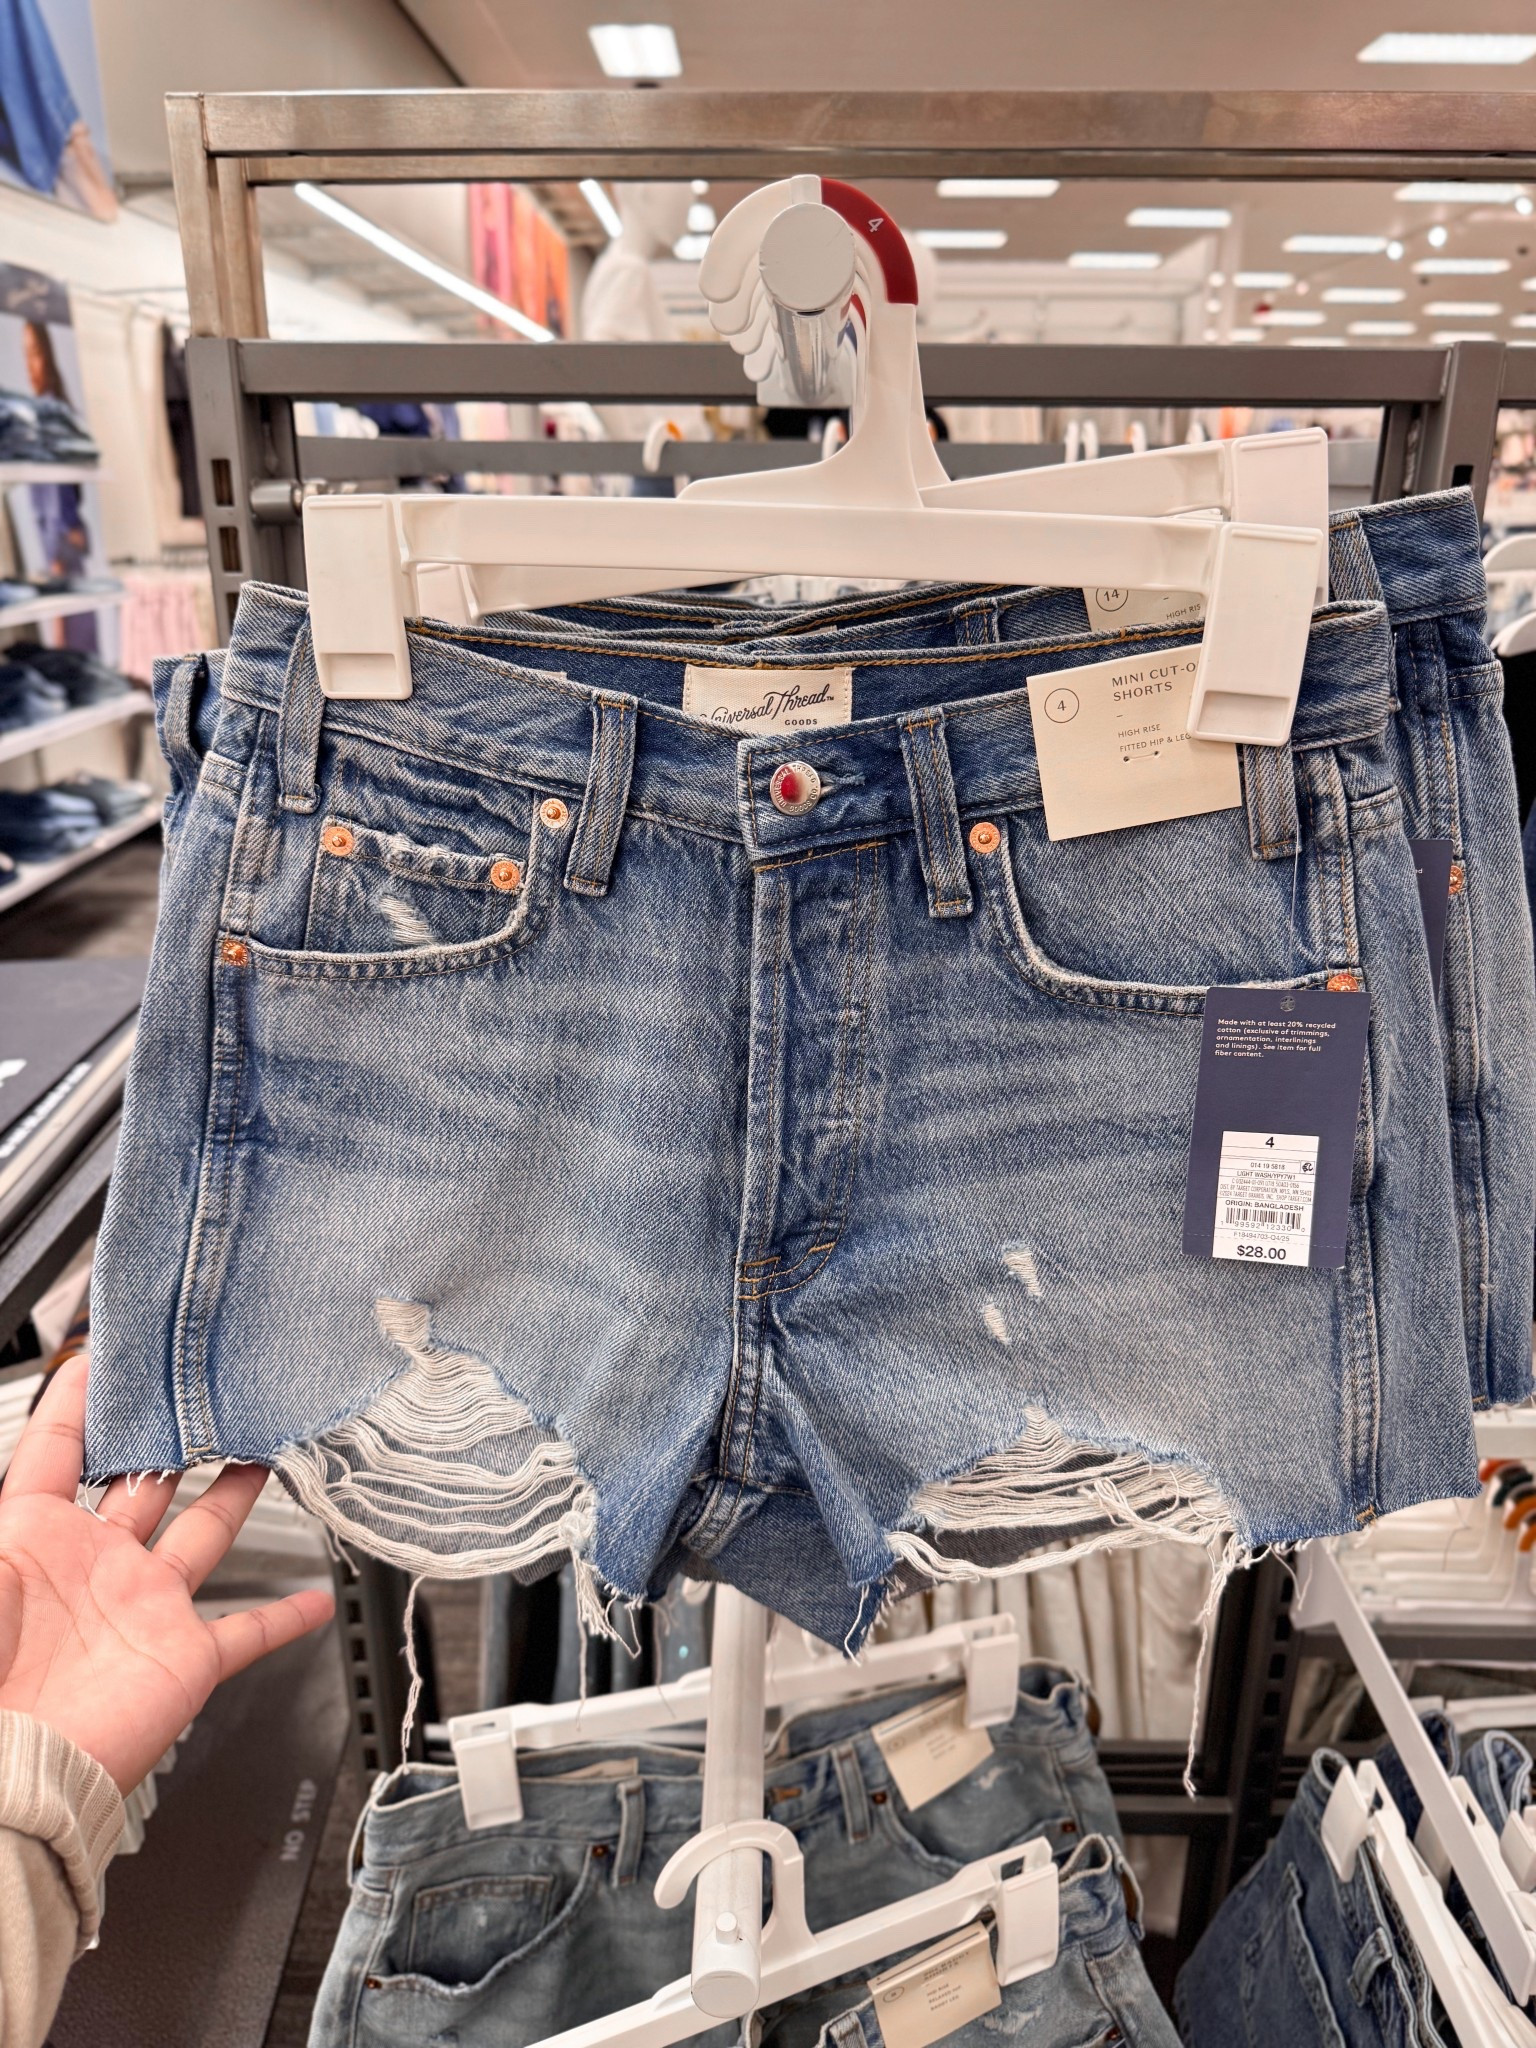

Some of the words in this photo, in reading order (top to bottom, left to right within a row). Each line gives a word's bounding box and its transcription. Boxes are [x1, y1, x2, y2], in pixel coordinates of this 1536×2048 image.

[868, 217, 883, 233] 4
[1103, 589, 1120, 602] 14
[1166, 607, 1187, 620] HIGH
[1189, 603, 1201, 613] RIS
[1112, 672, 1144, 688] MINI
[1149, 662, 1198, 680] CUT-O
[1113, 681, 1173, 702] SHORTS
[1057, 700, 1067, 711] 4
[1118, 728, 1140, 738] HIGH
[1143, 724, 1161, 735] RISE
[1120, 741, 1147, 753] FITTED
[1150, 738, 1164, 747] HIP
[1166, 735, 1173, 743] &
[1175, 732, 1192, 742] LEG
[1291, 1029, 1330, 1037] trimmings,
[1276, 1037, 1316, 1045] interlinings
[1265, 1137, 1274, 1147] 4
[1255, 1202, 1304, 1211] BANGLADESH
[1237, 1245, 1286, 1260] $28.00
[280, 1830, 304, 1860] NO
